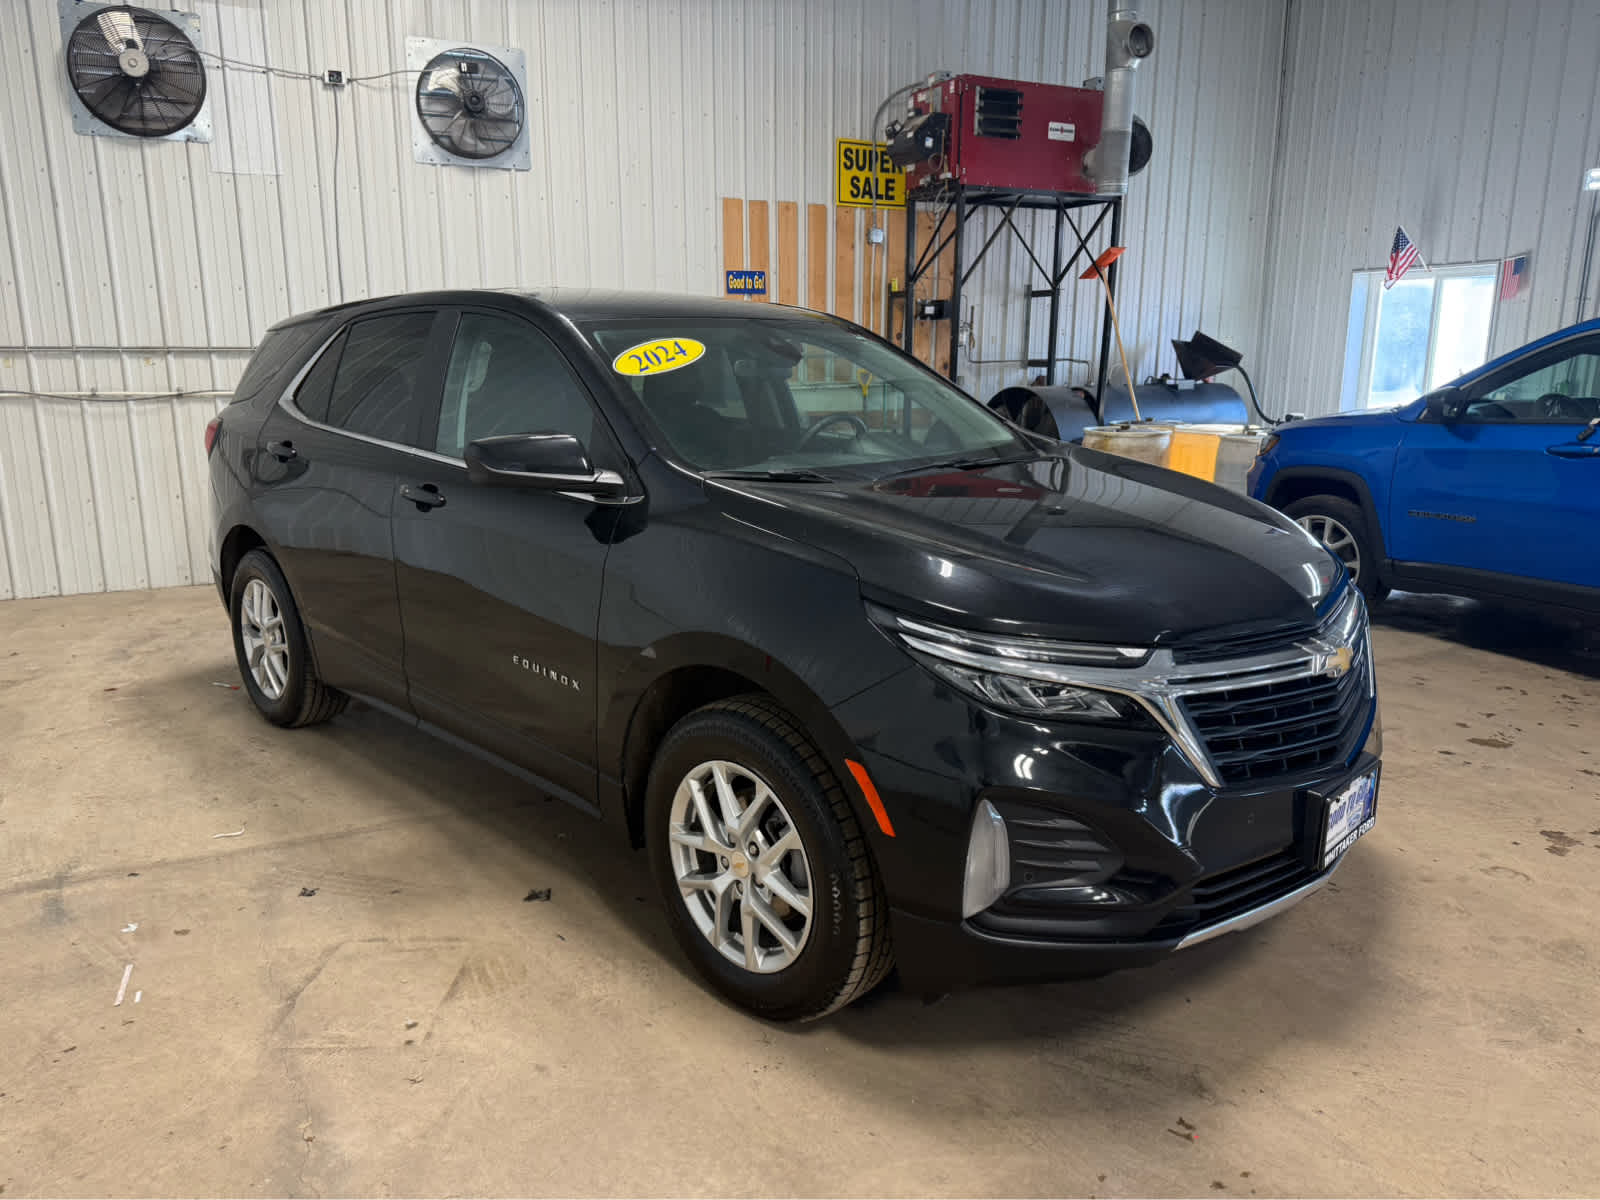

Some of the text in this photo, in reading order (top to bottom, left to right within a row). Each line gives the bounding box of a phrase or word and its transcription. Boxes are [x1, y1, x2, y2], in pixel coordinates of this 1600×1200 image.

[850, 175, 896, 201] SALE
[729, 274, 745, 289] Good
[746, 275, 753, 289] to
[629, 341, 687, 372] 2024
[512, 655, 581, 691] EQUINOX
[1324, 816, 1375, 868] WHITTAKER FORD
